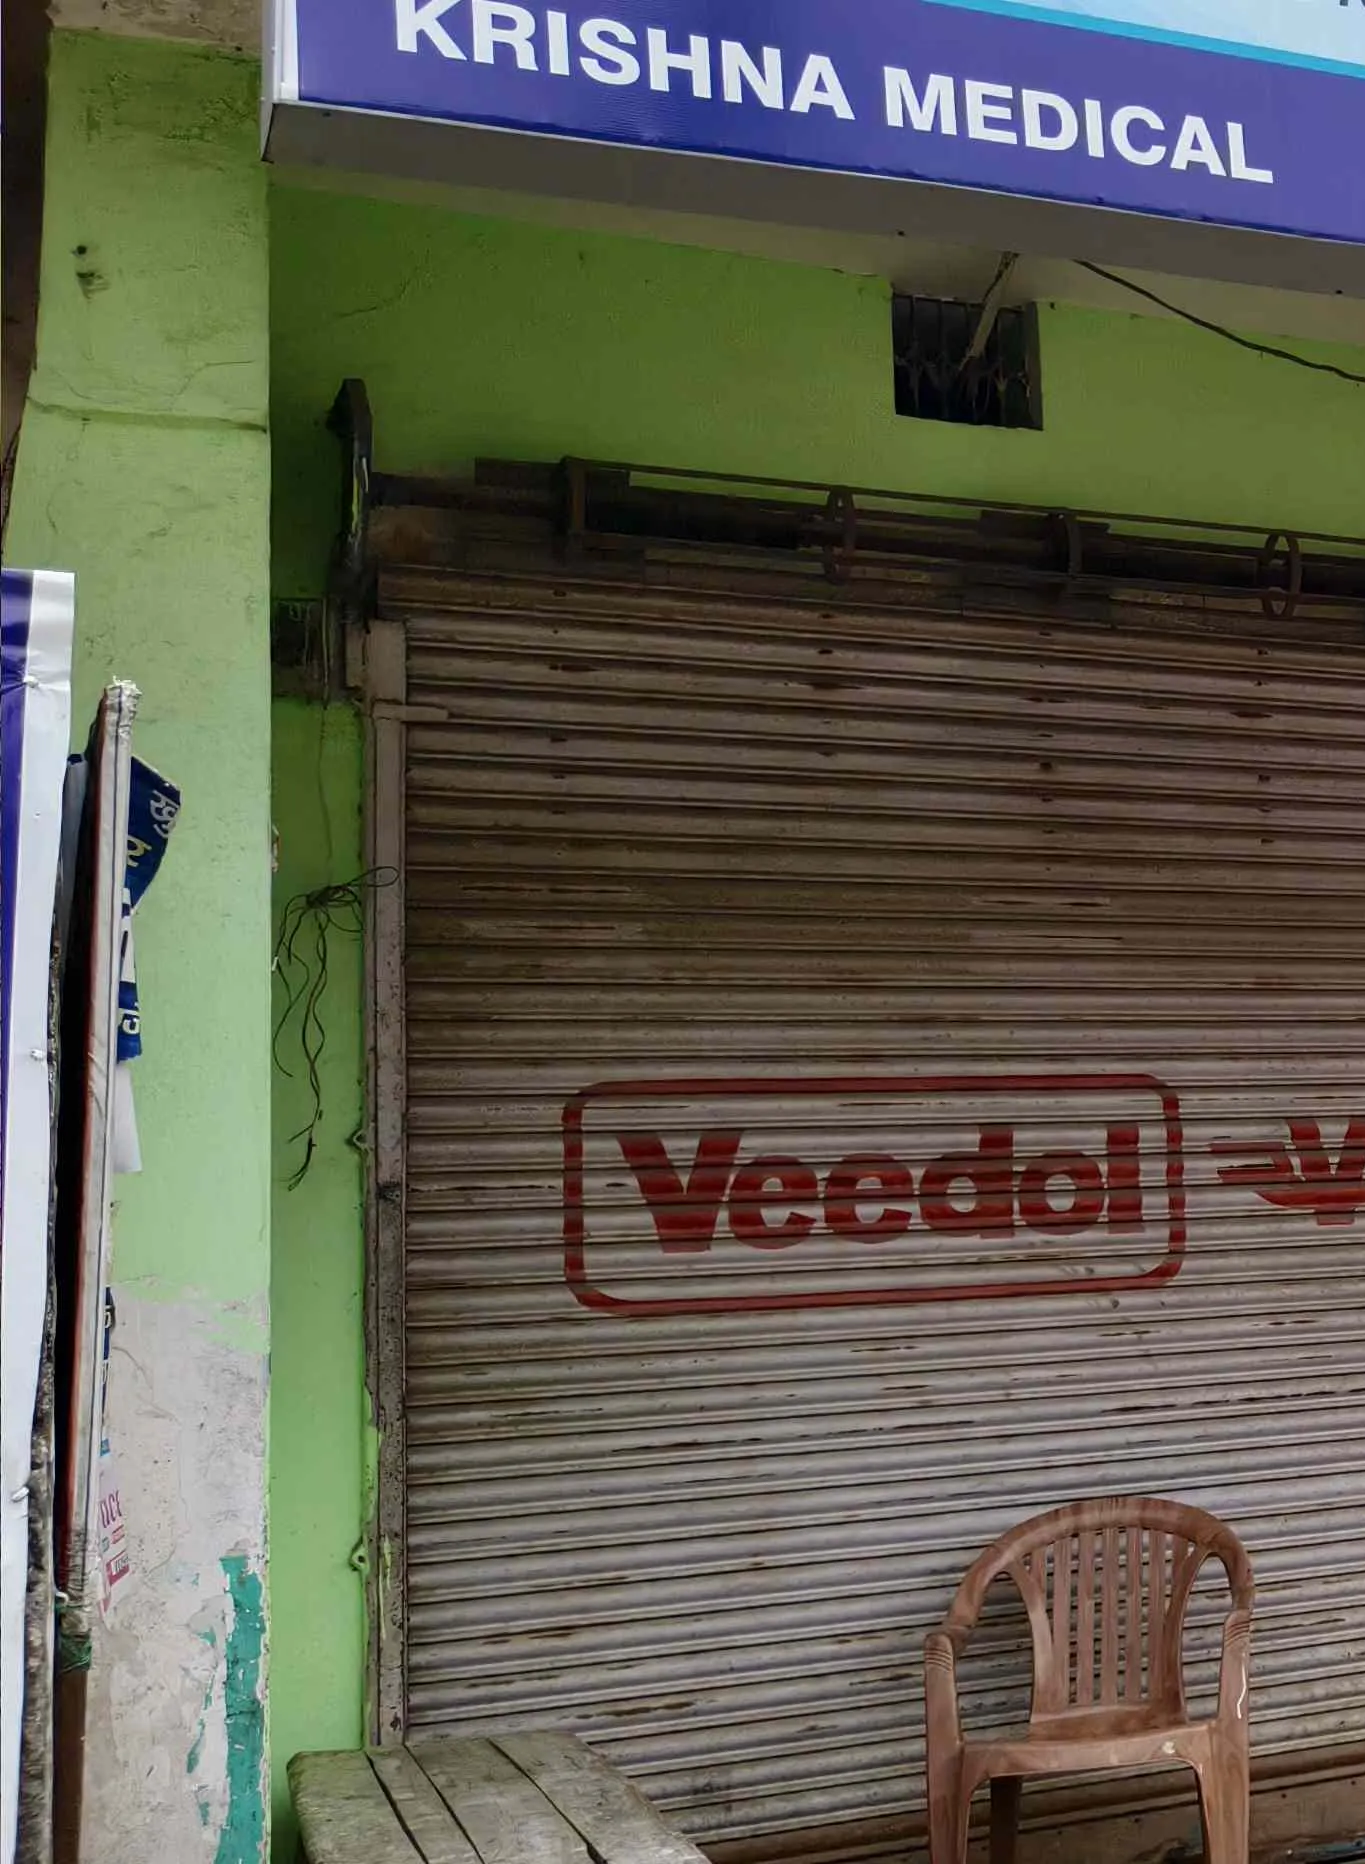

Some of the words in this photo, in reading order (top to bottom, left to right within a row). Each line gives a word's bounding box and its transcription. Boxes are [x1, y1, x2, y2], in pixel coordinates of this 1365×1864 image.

[397, 0, 854, 120] KRISHNA
[884, 67, 1274, 184] MEDICAL
[617, 1121, 1145, 1254] Veedol
